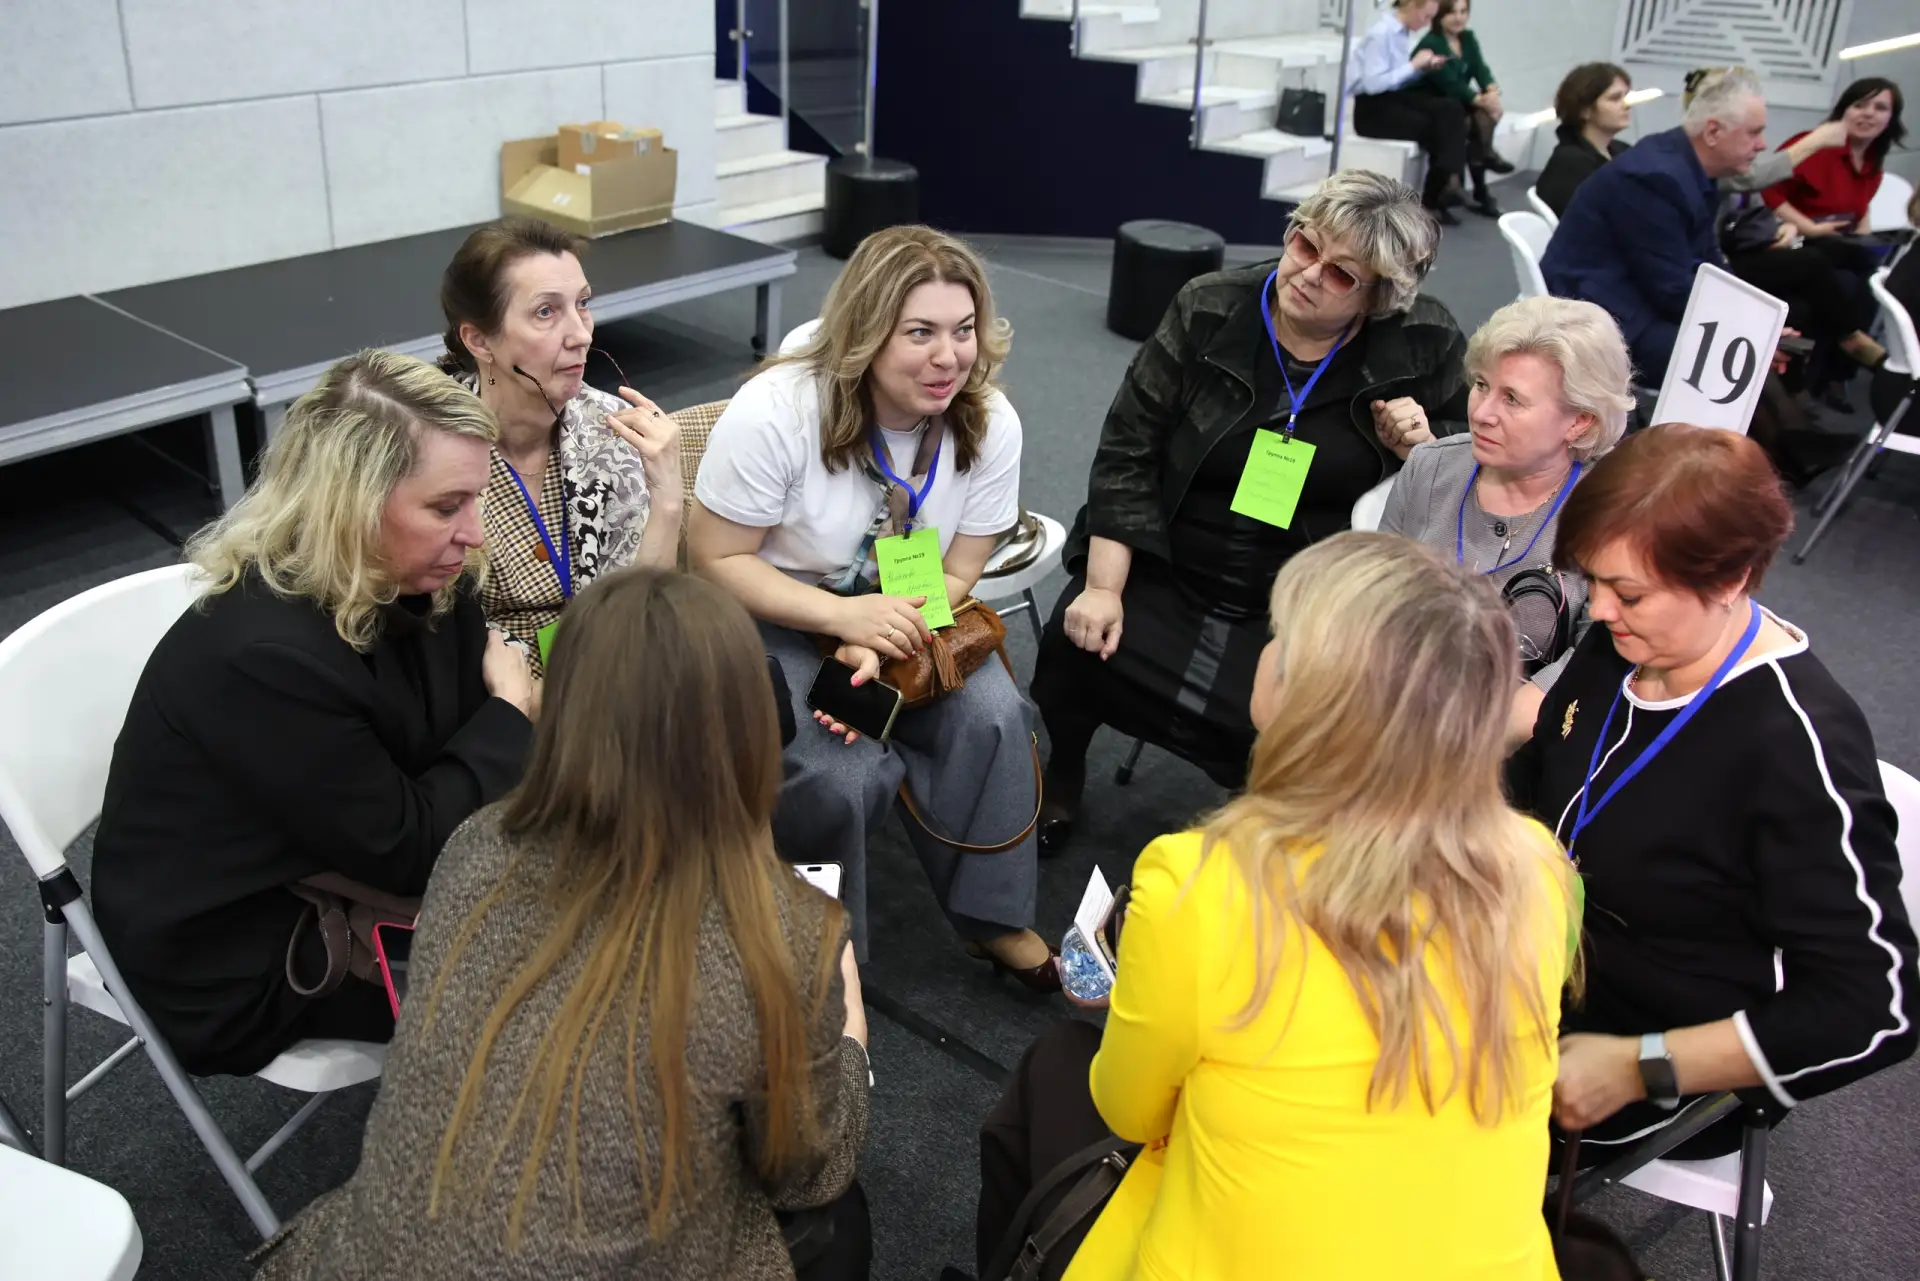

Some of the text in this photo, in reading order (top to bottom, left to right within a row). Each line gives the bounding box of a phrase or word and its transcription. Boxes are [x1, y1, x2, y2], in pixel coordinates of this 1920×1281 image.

[1682, 321, 1756, 405] 19
[1266, 449, 1296, 464] Группа №19
[894, 552, 925, 564] Группа №19
